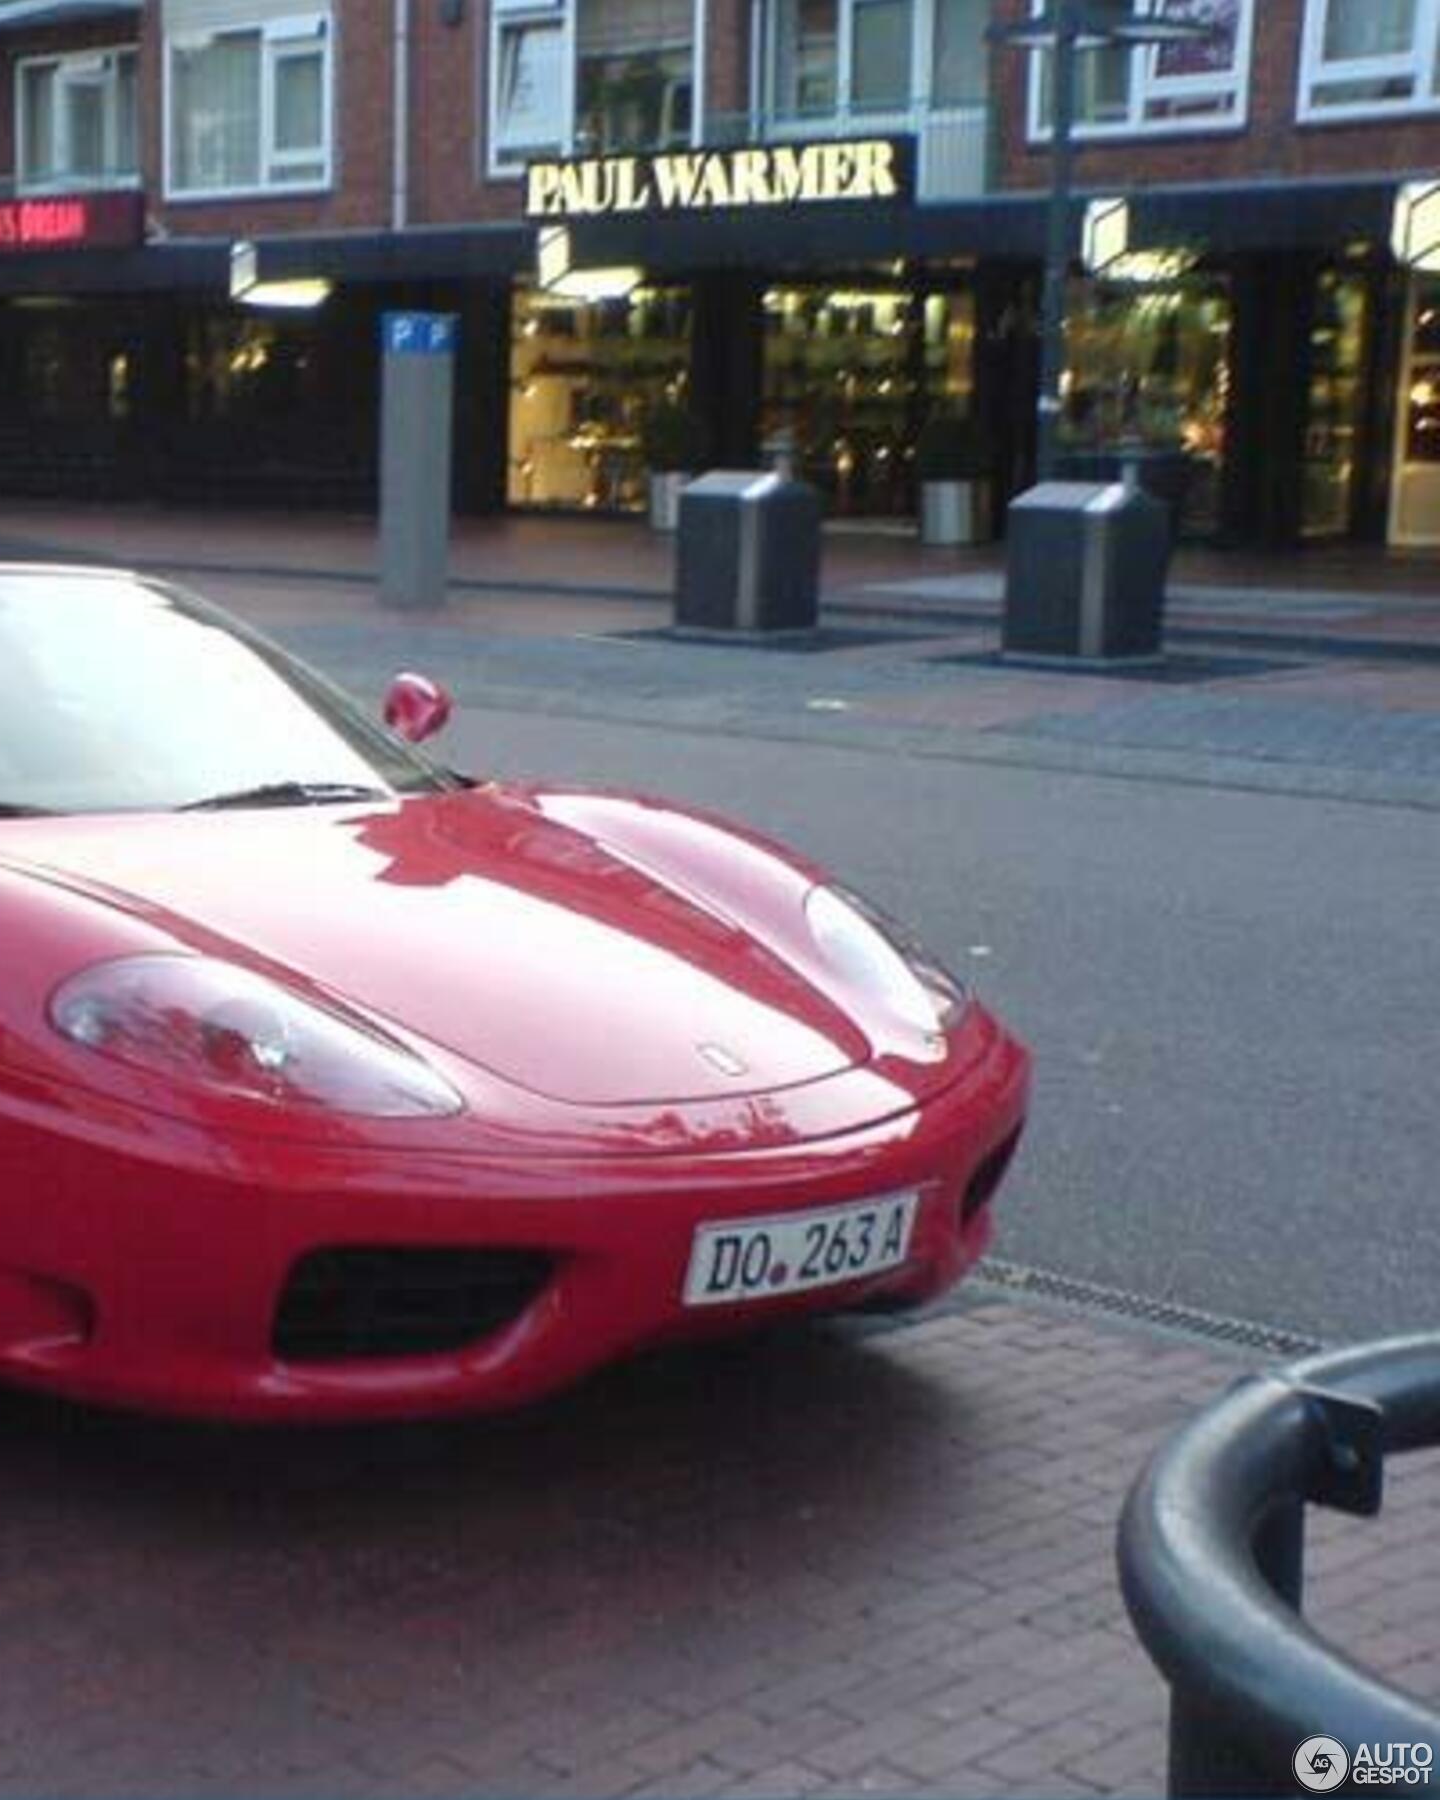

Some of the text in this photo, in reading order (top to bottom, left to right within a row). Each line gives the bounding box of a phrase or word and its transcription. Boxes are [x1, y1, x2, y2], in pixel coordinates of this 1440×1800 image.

[527, 139, 897, 215] PAUL WARMER
[392, 318, 413, 351] P
[706, 1203, 905, 1293] DO 263 A
